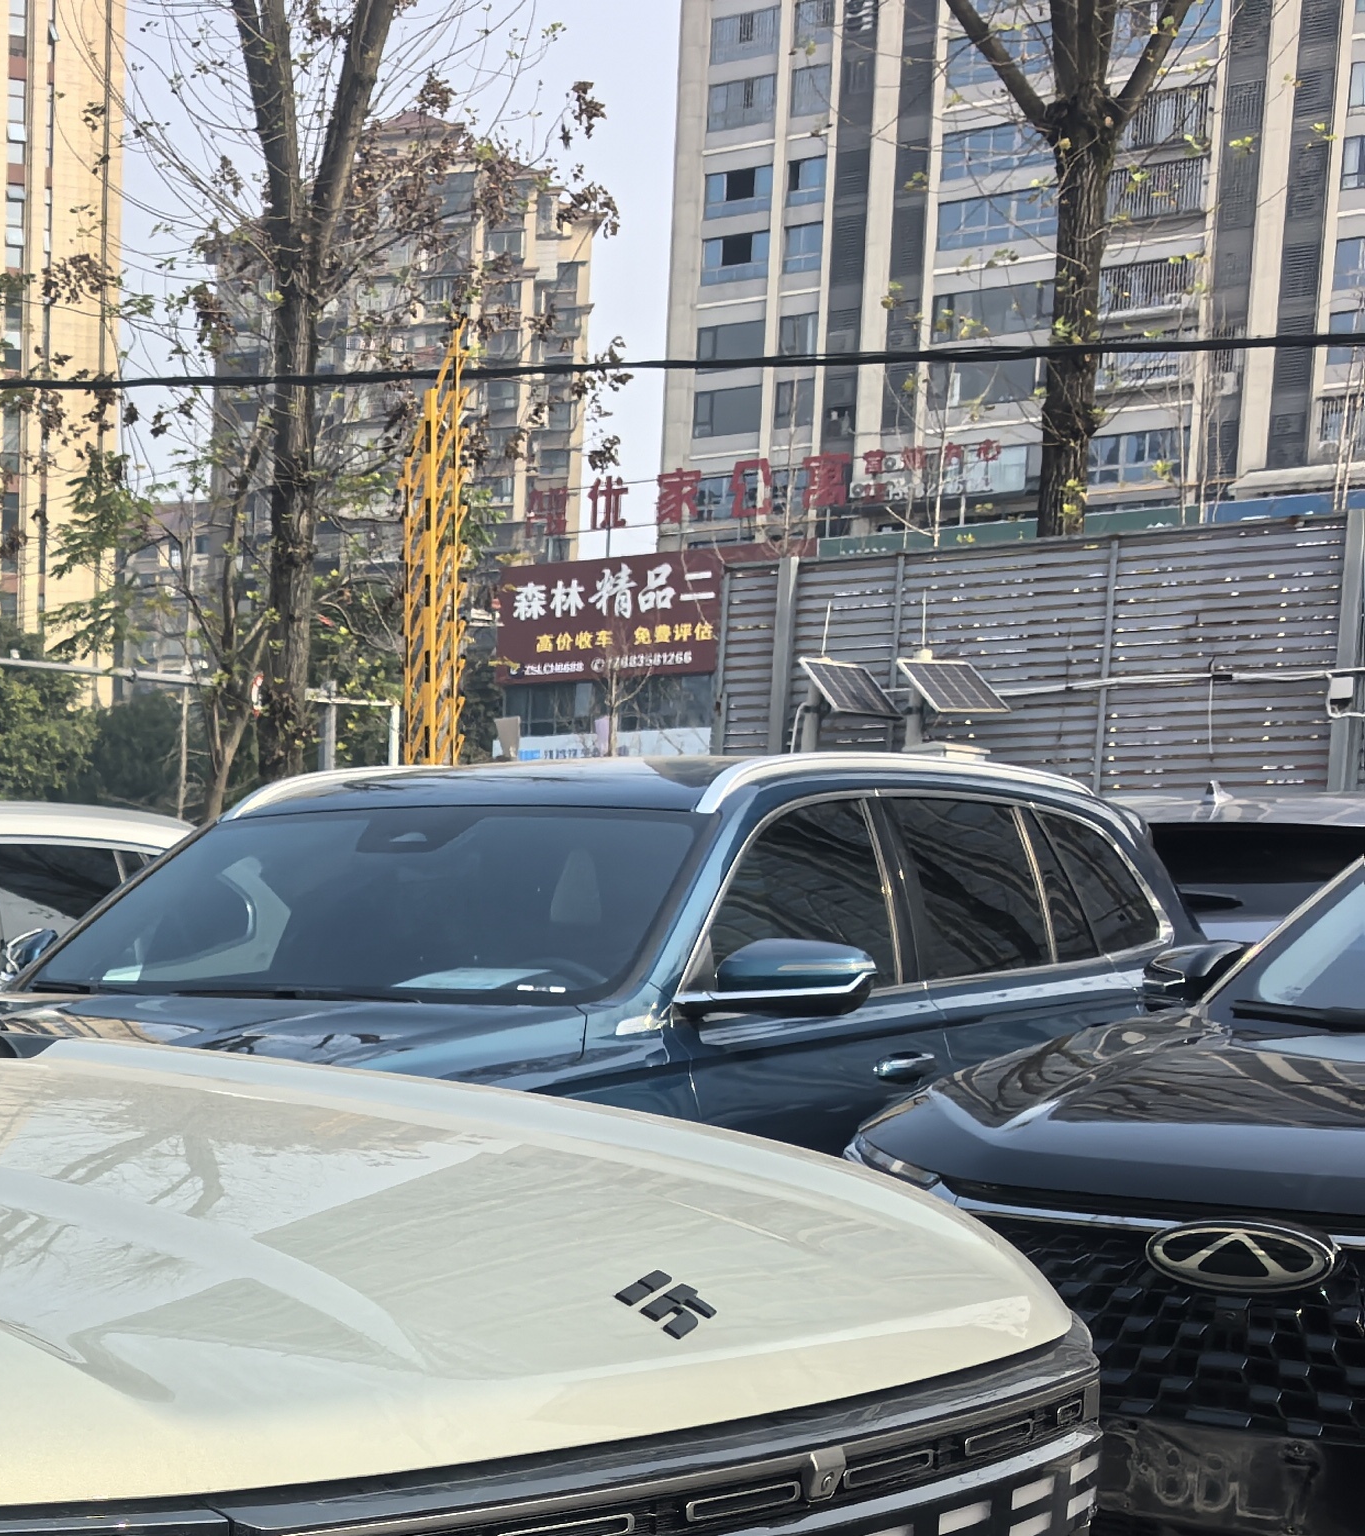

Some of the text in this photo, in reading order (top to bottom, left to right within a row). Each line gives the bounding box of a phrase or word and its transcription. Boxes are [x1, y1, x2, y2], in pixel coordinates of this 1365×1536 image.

[535, 623, 715, 653] 高价收车 免费评估
